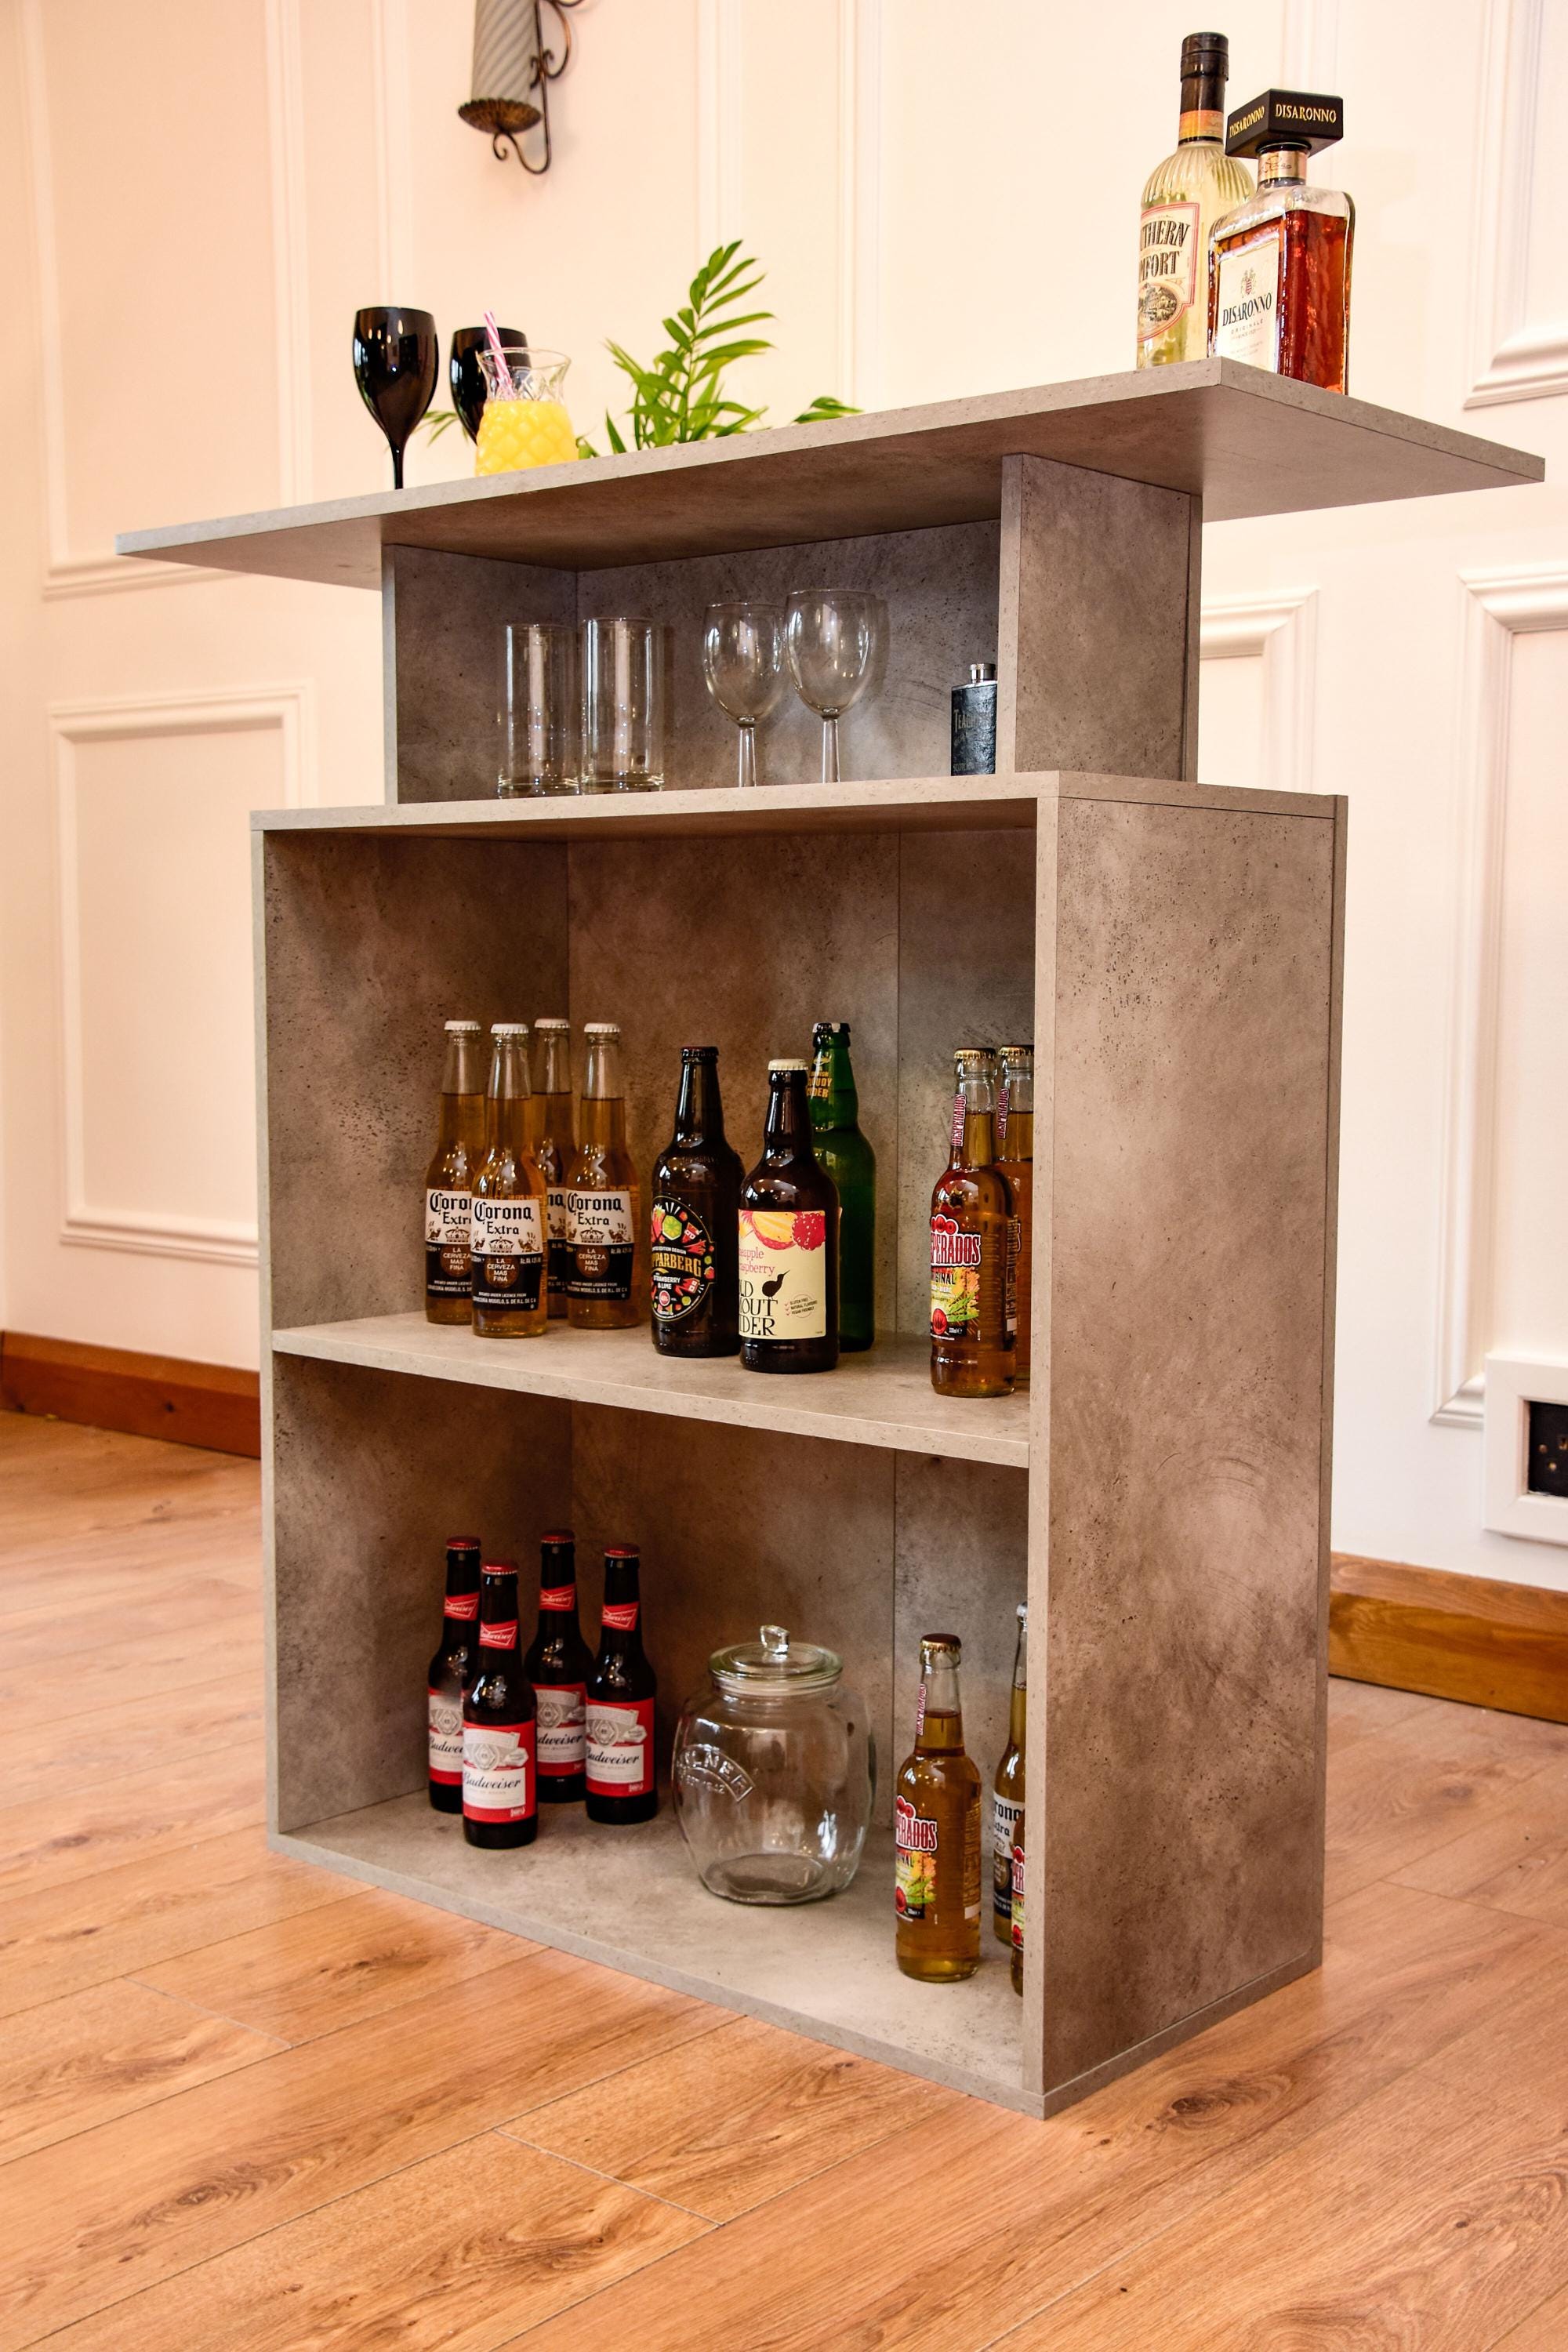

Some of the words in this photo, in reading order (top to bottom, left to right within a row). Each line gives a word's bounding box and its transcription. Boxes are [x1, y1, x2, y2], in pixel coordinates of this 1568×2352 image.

[1229, 106, 1265, 139] DISARONNO
[1276, 103, 1337, 124] DISARONNO
[1222, 292, 1272, 326] DISARONNO
[430, 1192, 471, 1214] Coro
[474, 1200, 533, 1222] Corona
[568, 1192, 624, 1213] Corona
[487, 1221, 520, 1235] Extra
[578, 1212, 609, 1225] Extra
[464, 1771, 521, 1788] Budweiser
